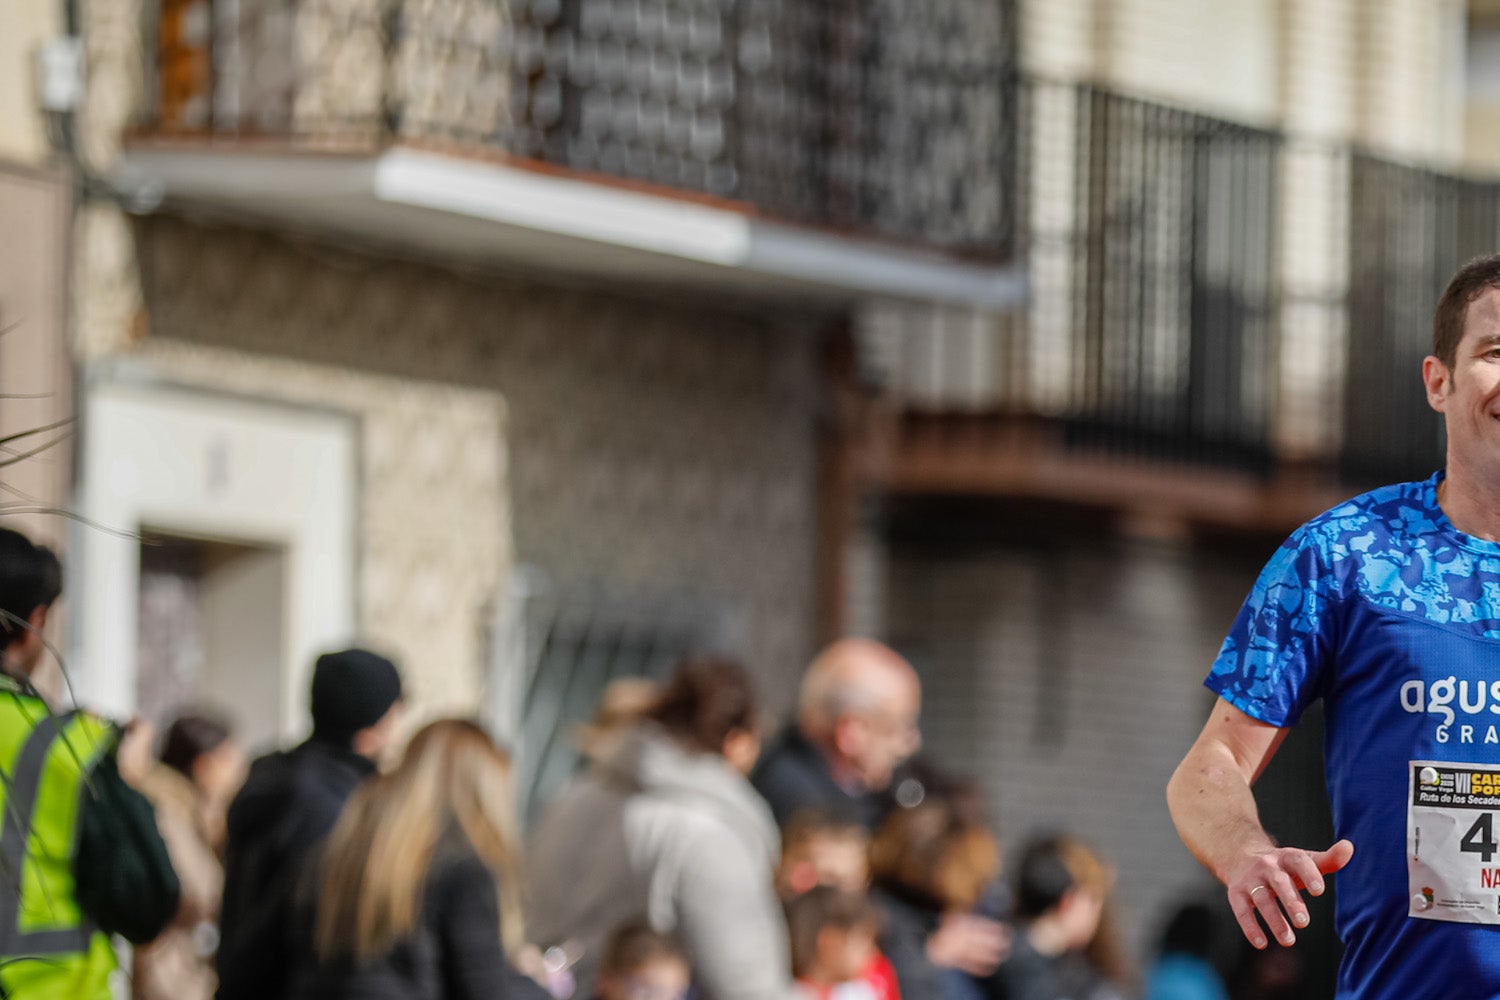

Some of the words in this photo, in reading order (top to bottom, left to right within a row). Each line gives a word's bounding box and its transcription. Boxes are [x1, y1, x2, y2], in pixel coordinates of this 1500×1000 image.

[1455, 772, 1472, 794] VII
[1420, 792, 1440, 802] Ruta
[1440, 794, 1452, 803] de
[1452, 795, 1467, 804] los
